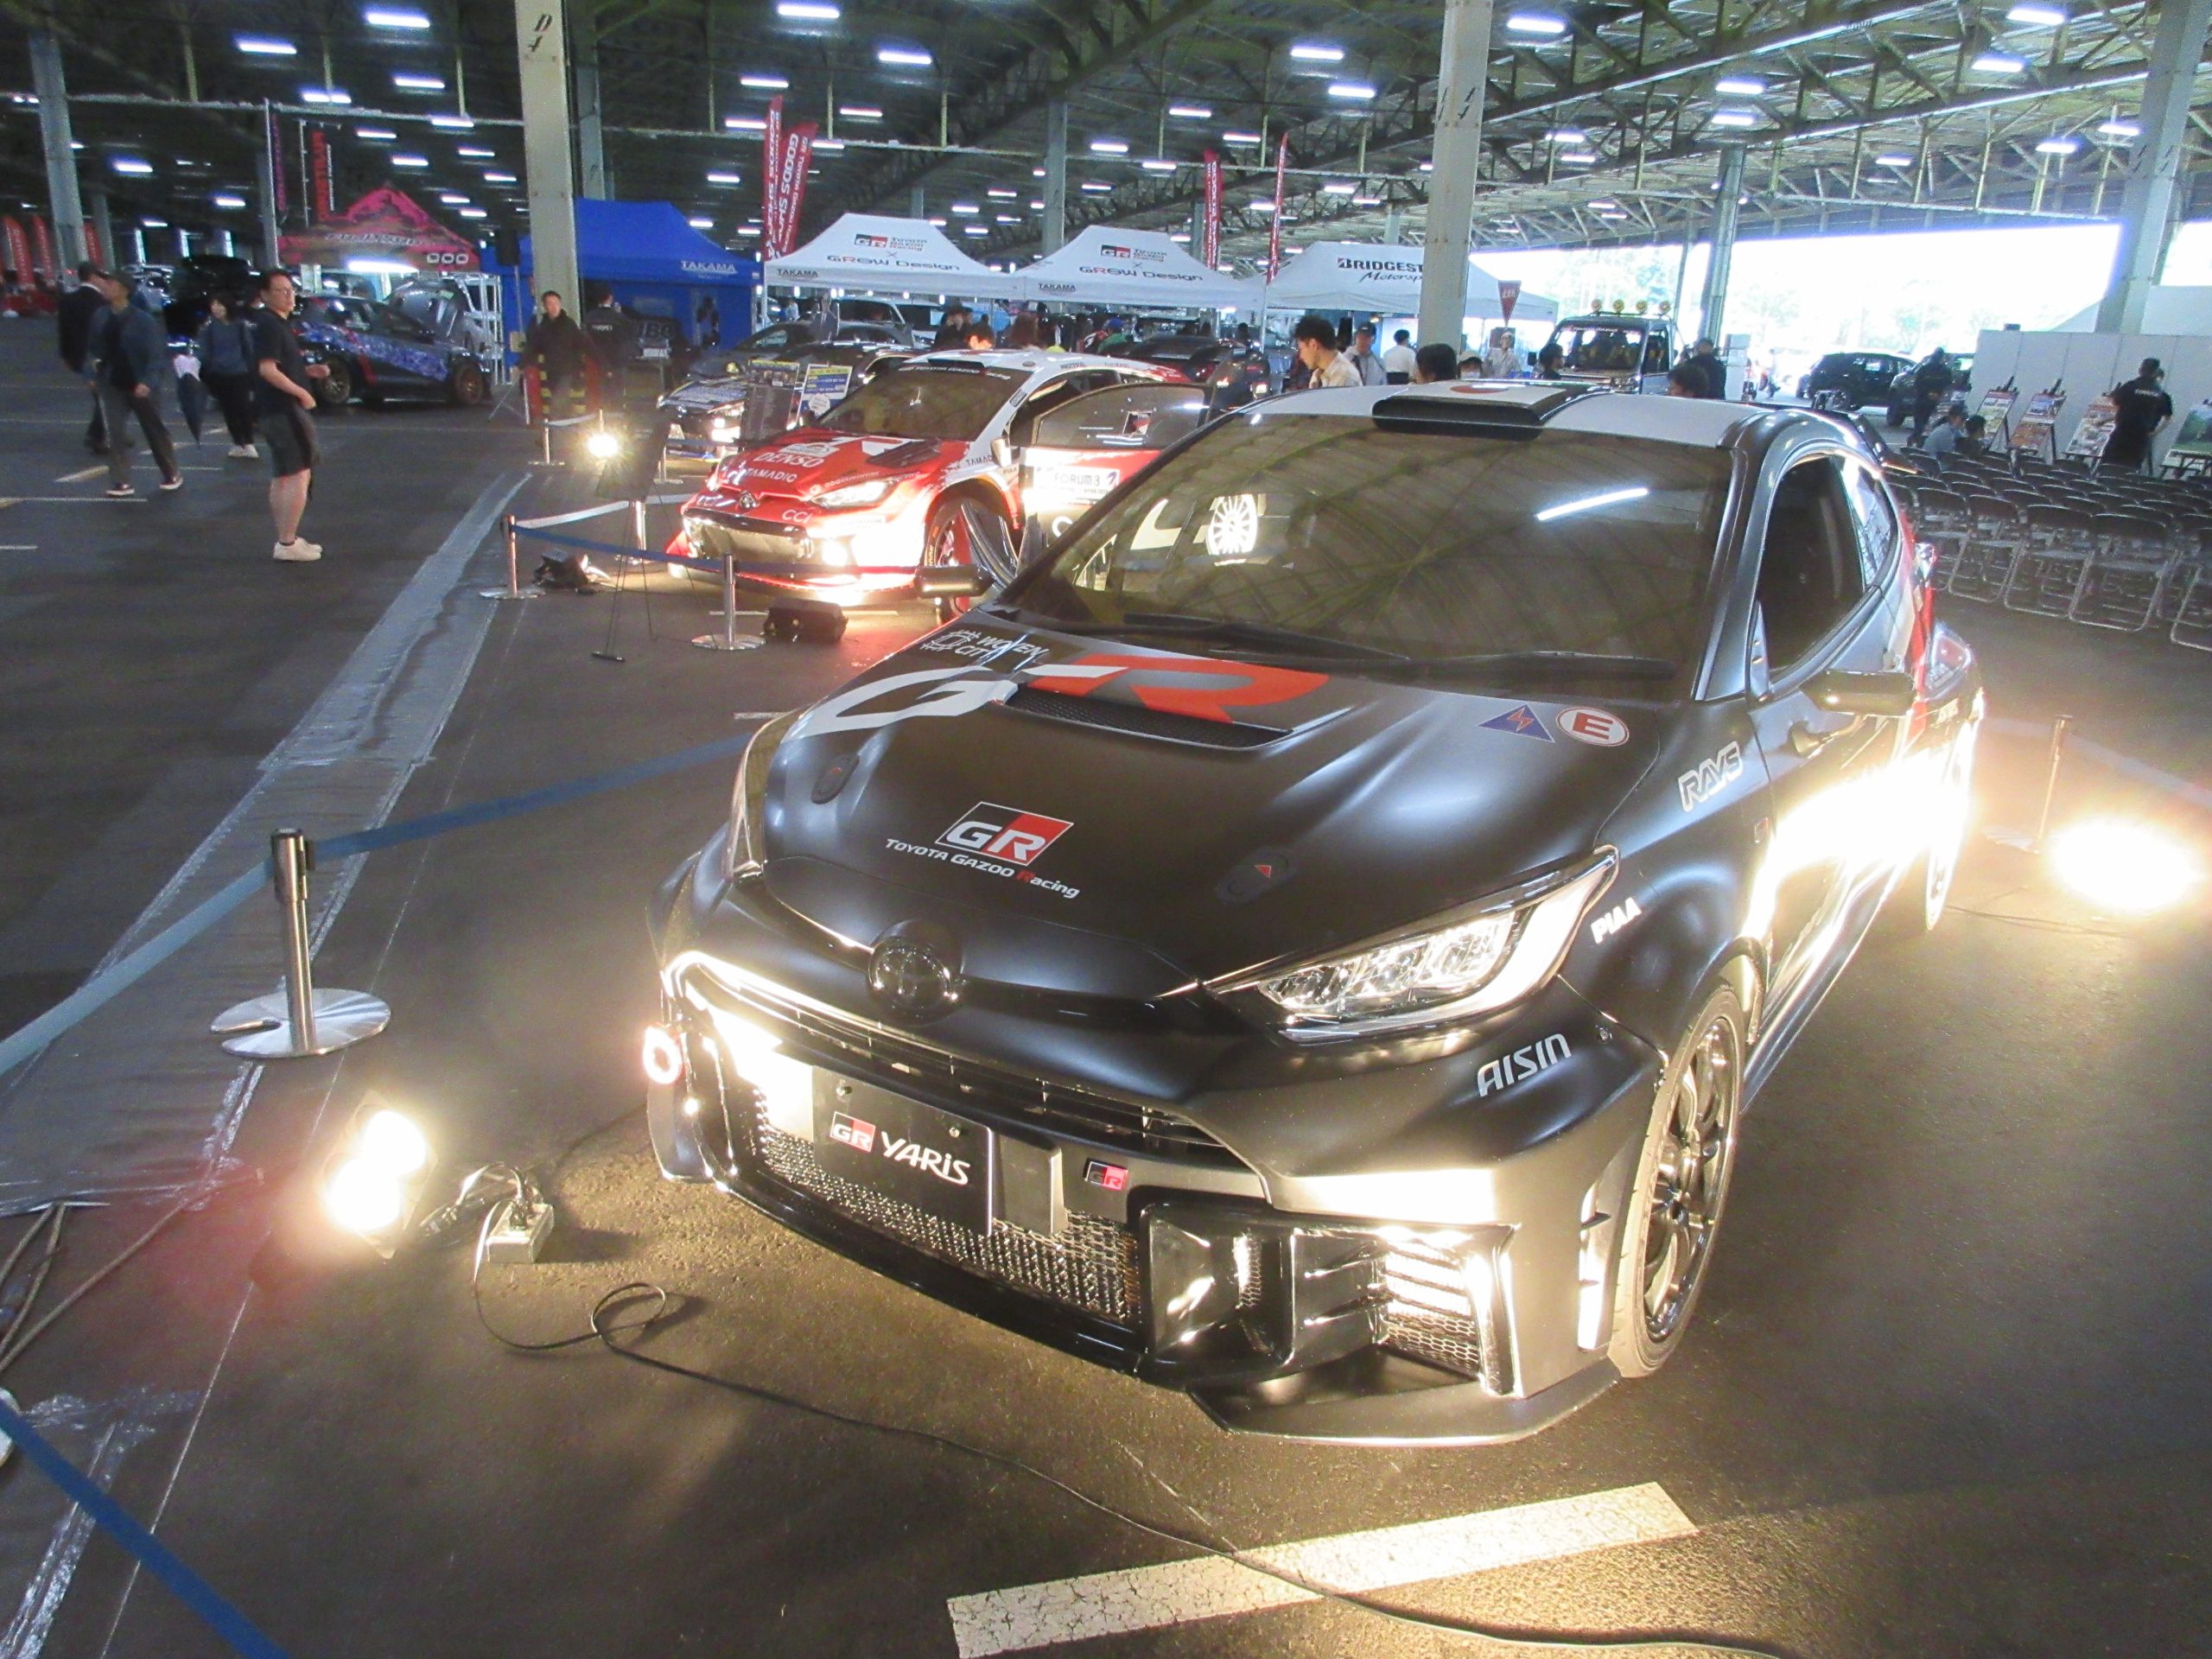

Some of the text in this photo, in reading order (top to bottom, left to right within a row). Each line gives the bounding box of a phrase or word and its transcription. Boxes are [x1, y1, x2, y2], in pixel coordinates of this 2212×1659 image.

[780, 132, 799, 195] GOODS
[681, 260, 738, 275] TAKAMA
[895, 260, 961, 270] Design
[1337, 257, 1423, 273] BRIDGEST
[777, 269, 819, 278] TAKAMA
[1142, 271, 1204, 282] Design
[1358, 270, 1423, 284] Motorsp
[1038, 283, 1076, 292] TAKAMA
[753, 452, 825, 468] DENSO
[966, 454, 995, 467] TAMAD
[746, 467, 798, 483] TAMADIC
[782, 509, 813, 524] CCI
[954, 645, 994, 658] CIT
[976, 636, 1050, 657] WOEN
[1572, 711, 1614, 741] E
[1677, 741, 1744, 812] RAYS
[945, 820, 1047, 862] GR
[886, 838, 1080, 899] TOYOTA GAZOO Racing
[1590, 897, 1643, 944] PIAA
[1476, 1033, 1572, 1097] AISIN
[831, 1123, 873, 1147] GR
[1090, 1169, 1123, 1189] GR
